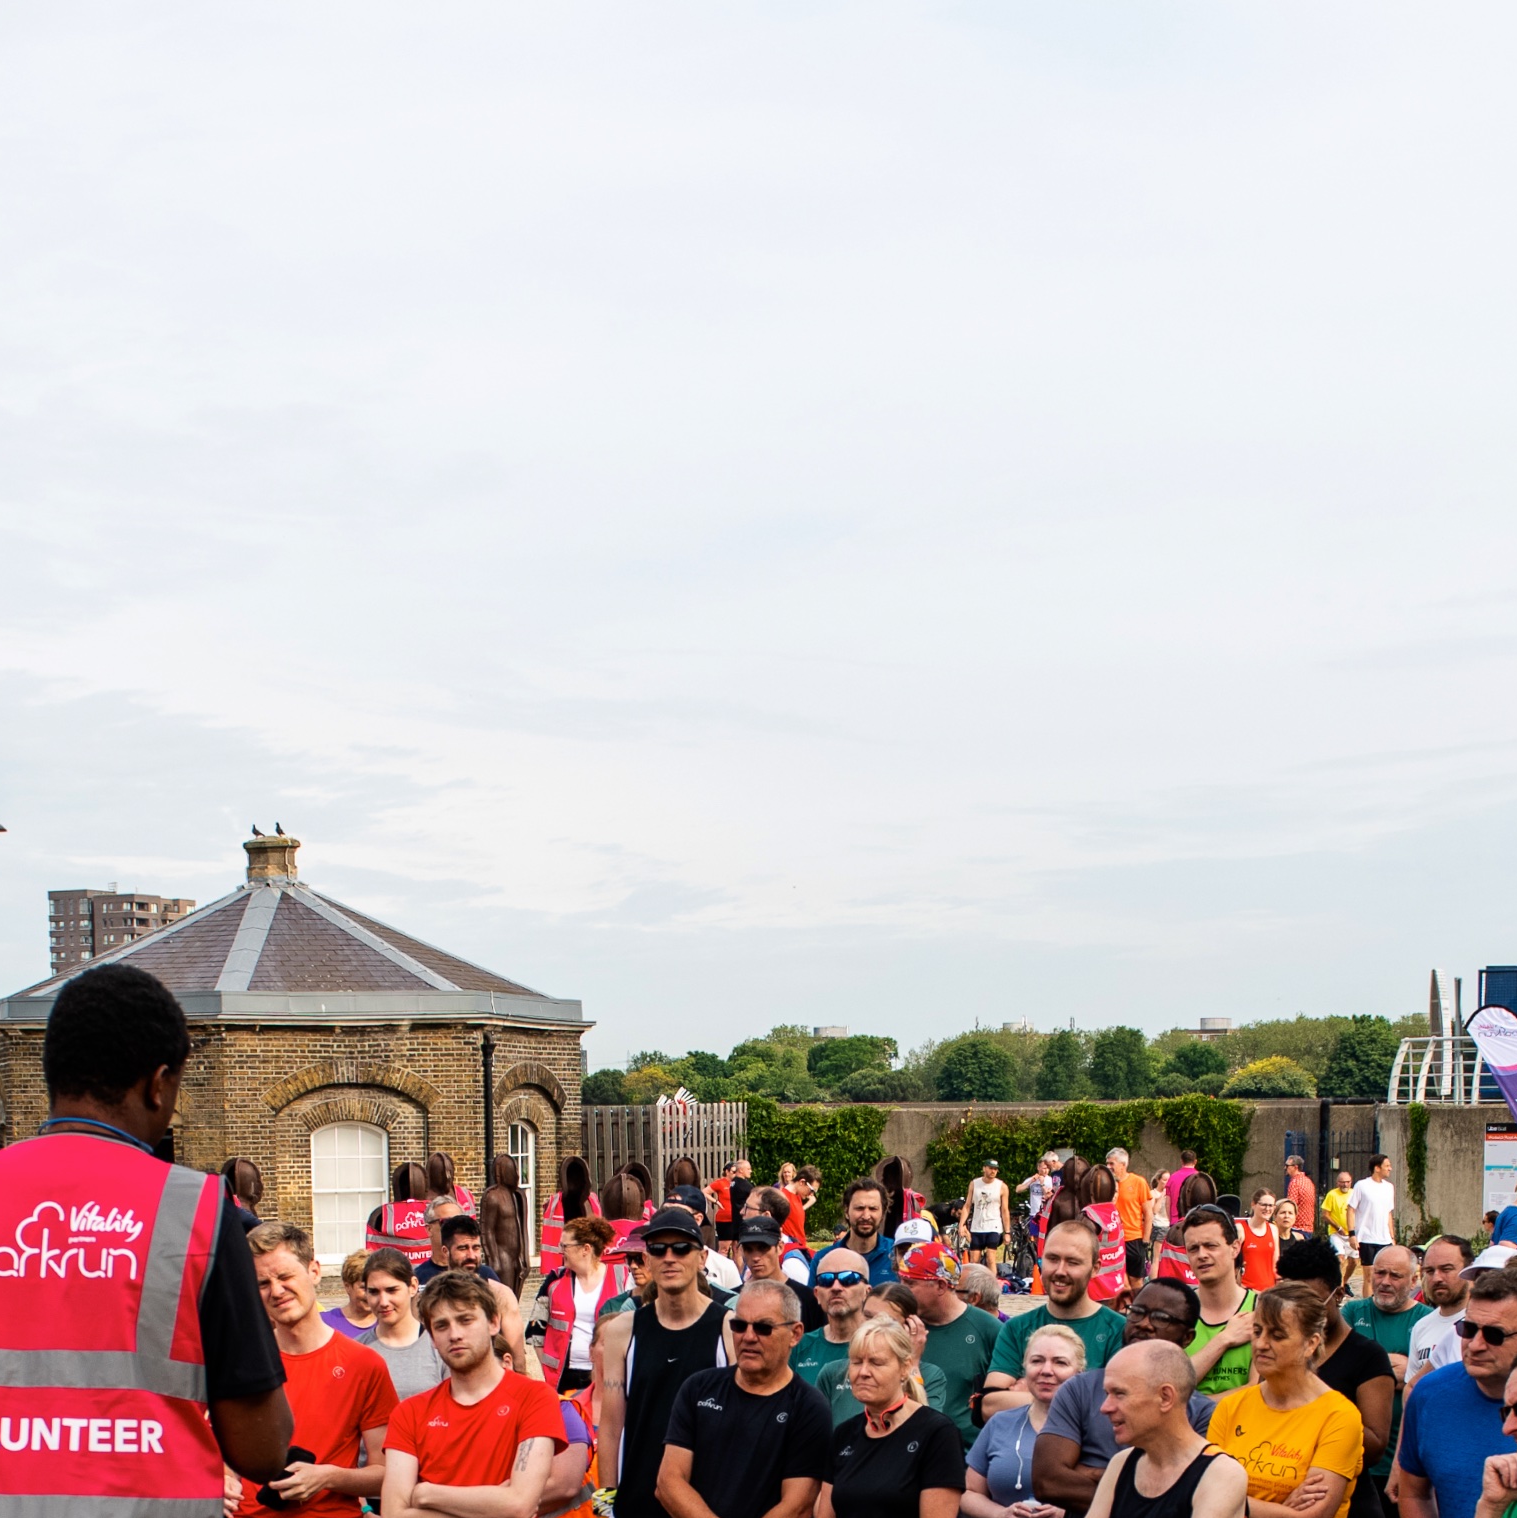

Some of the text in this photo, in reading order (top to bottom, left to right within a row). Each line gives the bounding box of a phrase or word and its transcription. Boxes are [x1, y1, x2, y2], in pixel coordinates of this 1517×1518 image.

[70, 1201, 143, 1243] Vitality
[1213, 1367, 1248, 1375] UNNERS
[1271, 1443, 1302, 1462] Vitality
